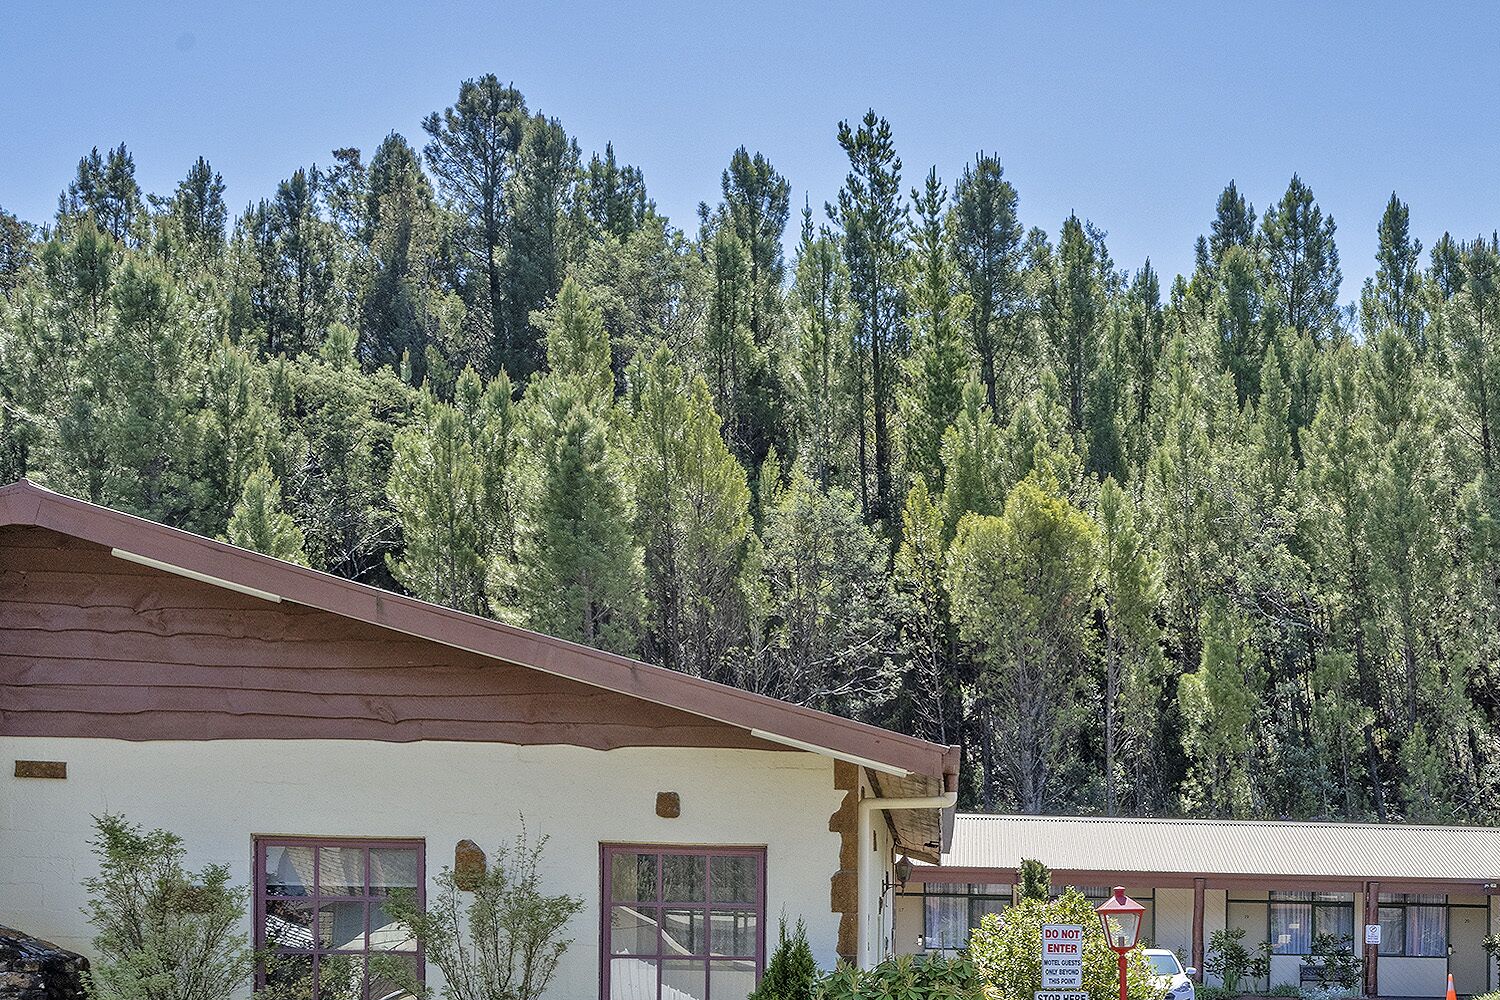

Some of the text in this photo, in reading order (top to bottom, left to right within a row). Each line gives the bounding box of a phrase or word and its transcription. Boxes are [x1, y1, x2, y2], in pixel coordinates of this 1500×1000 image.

[1045, 930, 1080, 938] DO NOT
[1048, 944, 1077, 953] ENTER
